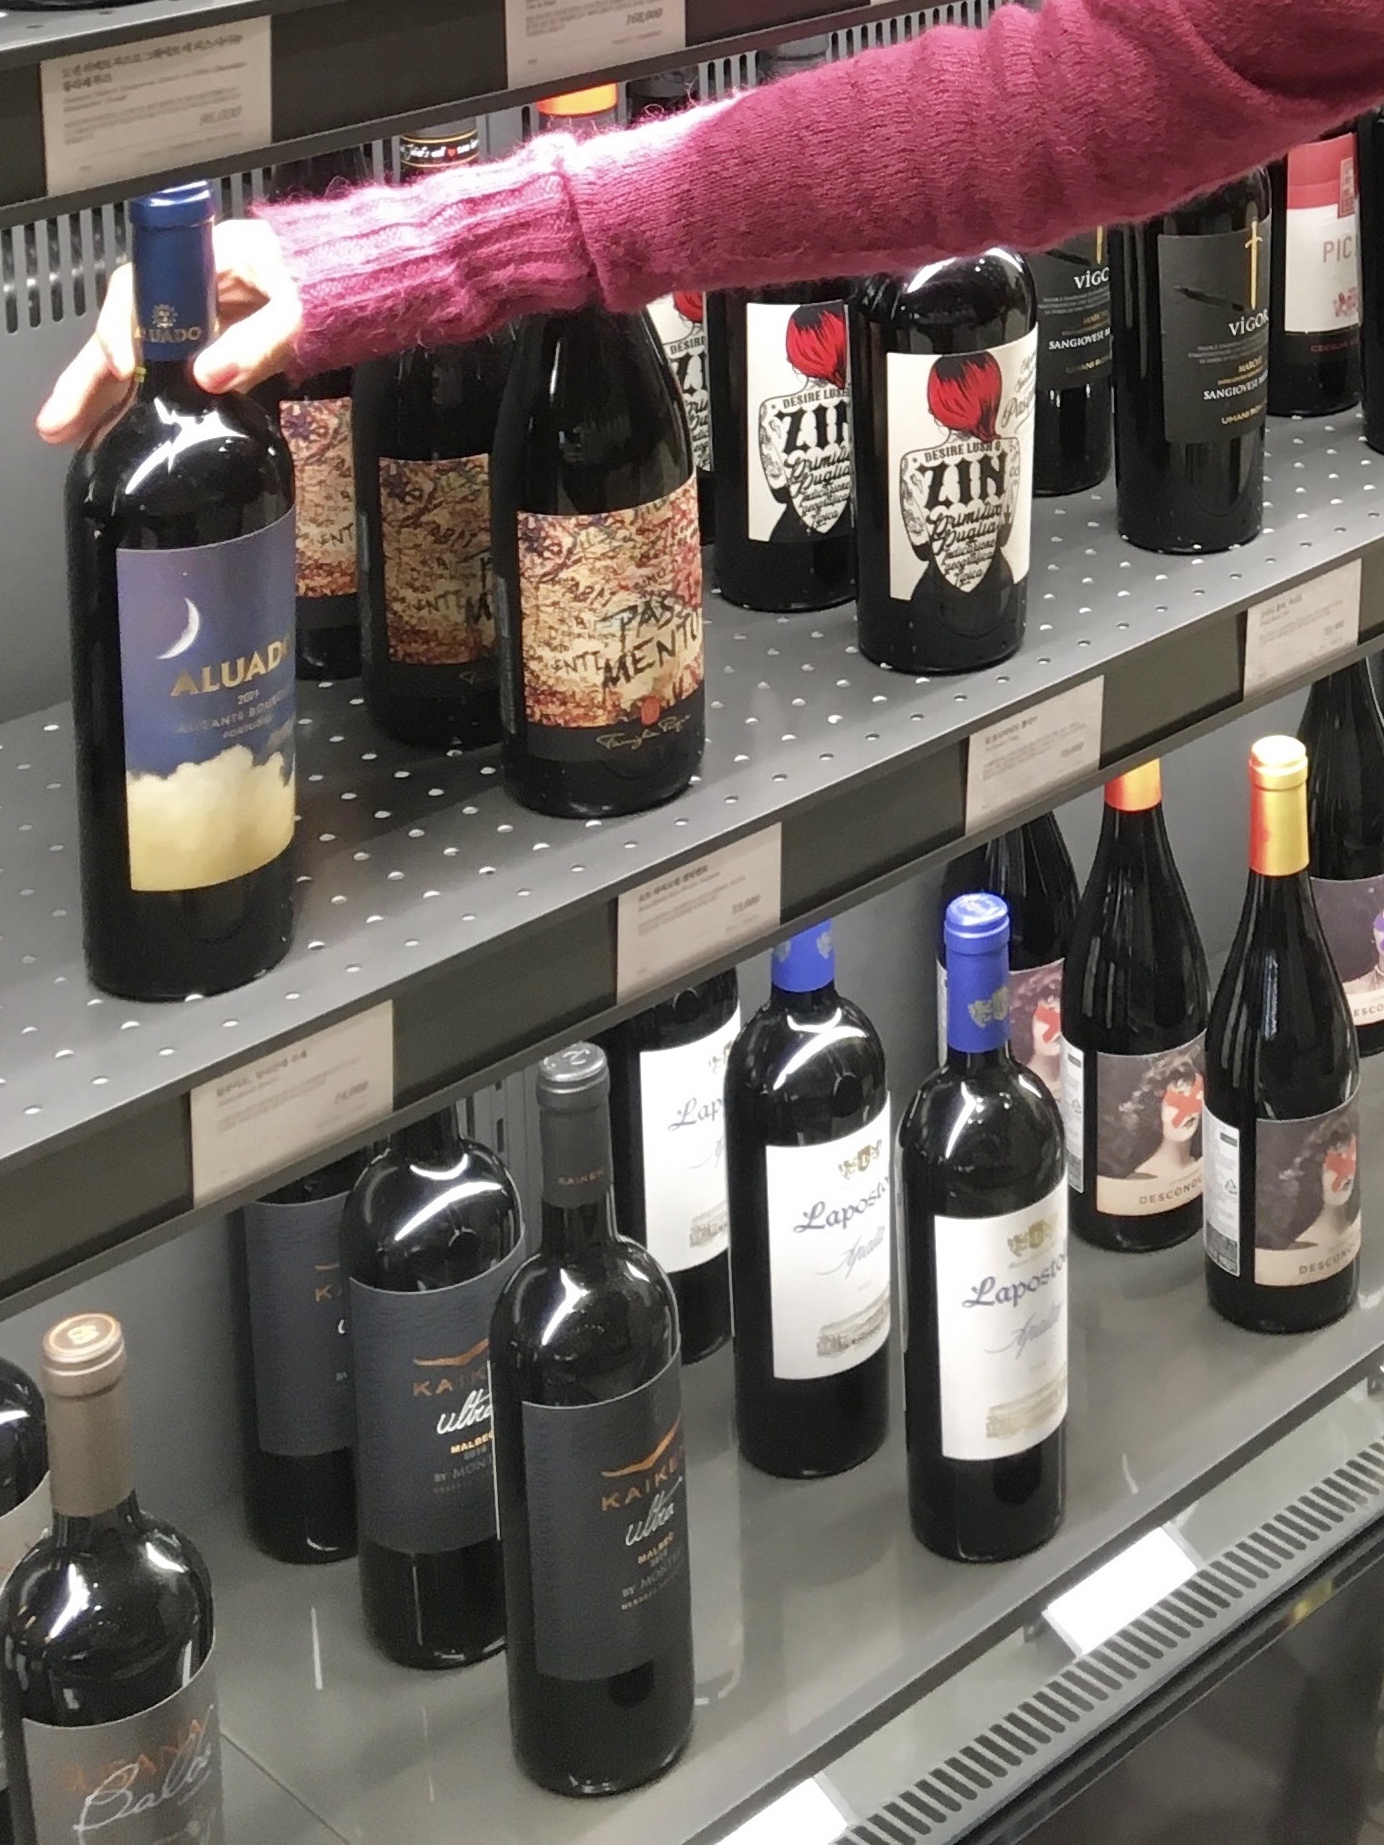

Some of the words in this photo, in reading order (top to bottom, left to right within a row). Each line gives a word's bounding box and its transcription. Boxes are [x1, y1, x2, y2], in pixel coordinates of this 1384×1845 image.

[1049, 332, 1102, 350] SANGIOVESE
[783, 391, 820, 409] DESIRE
[925, 446, 963, 462] DESIRE
[967, 442, 992, 454] LUSH
[916, 449, 1007, 509] ZIN
